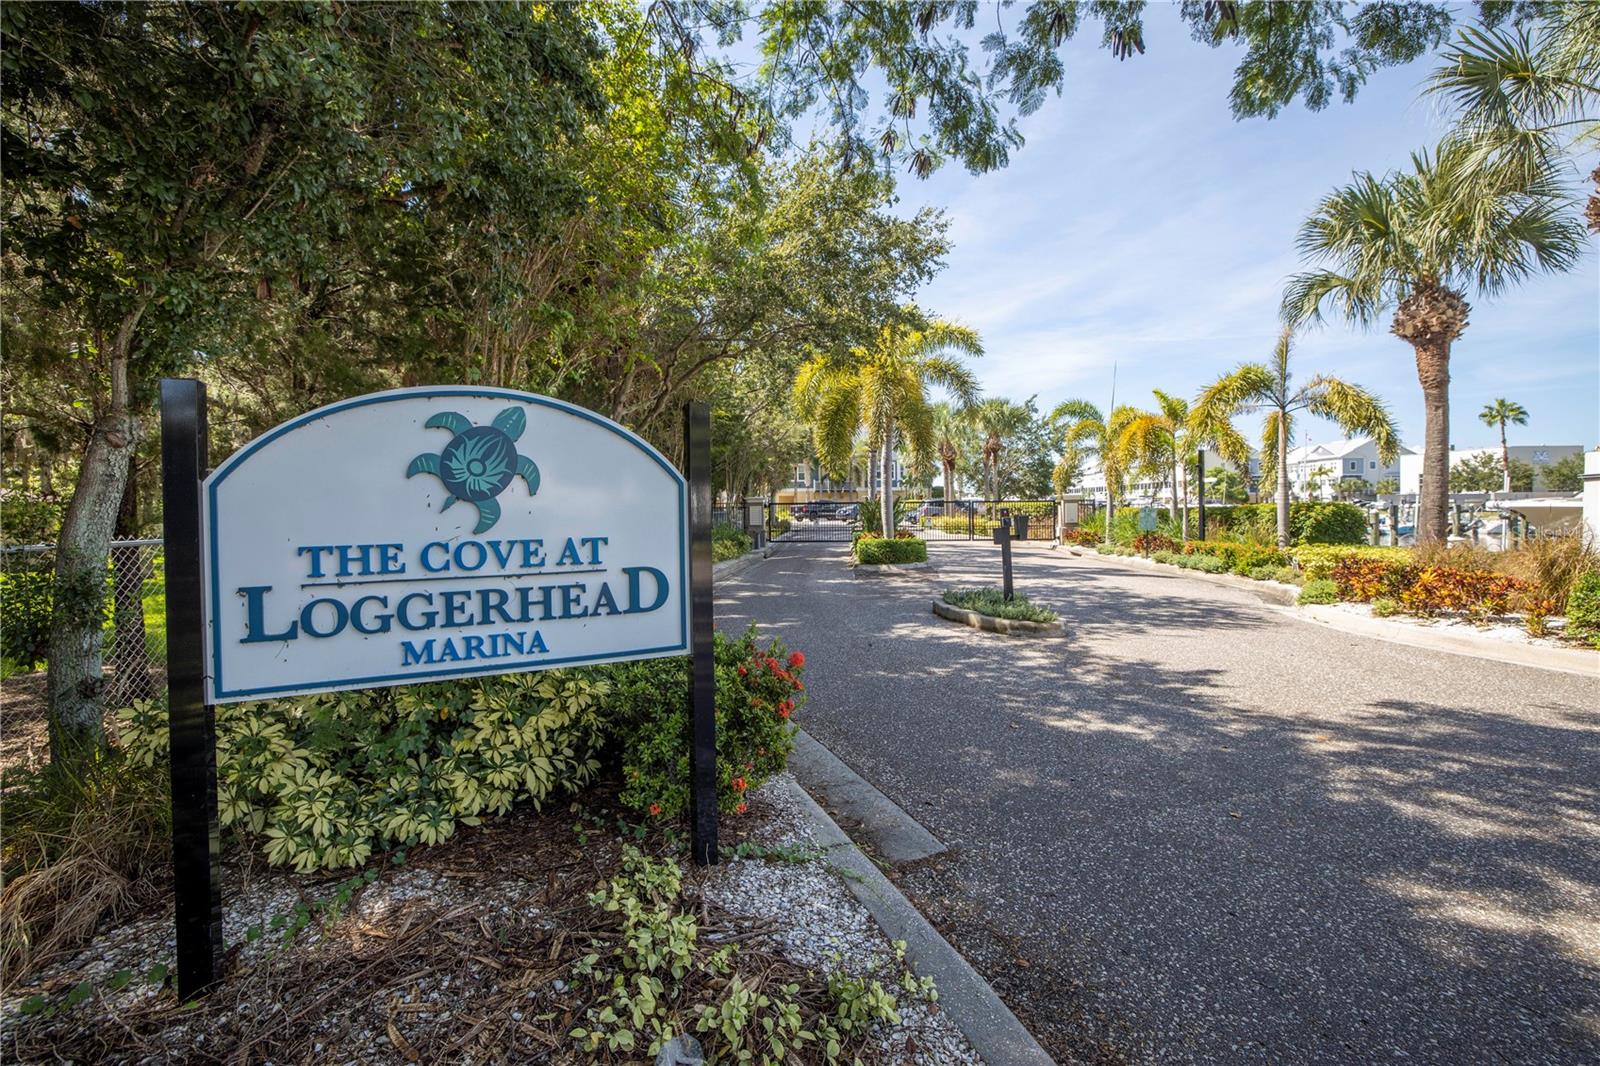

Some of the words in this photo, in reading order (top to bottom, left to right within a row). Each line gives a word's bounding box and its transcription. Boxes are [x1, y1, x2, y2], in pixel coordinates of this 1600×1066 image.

[298, 542, 406, 578] THE
[419, 537, 548, 573] COVE
[556, 536, 609, 566] AT
[239, 565, 670, 644] LOGGERHEAD
[400, 630, 550, 666] MARINA
